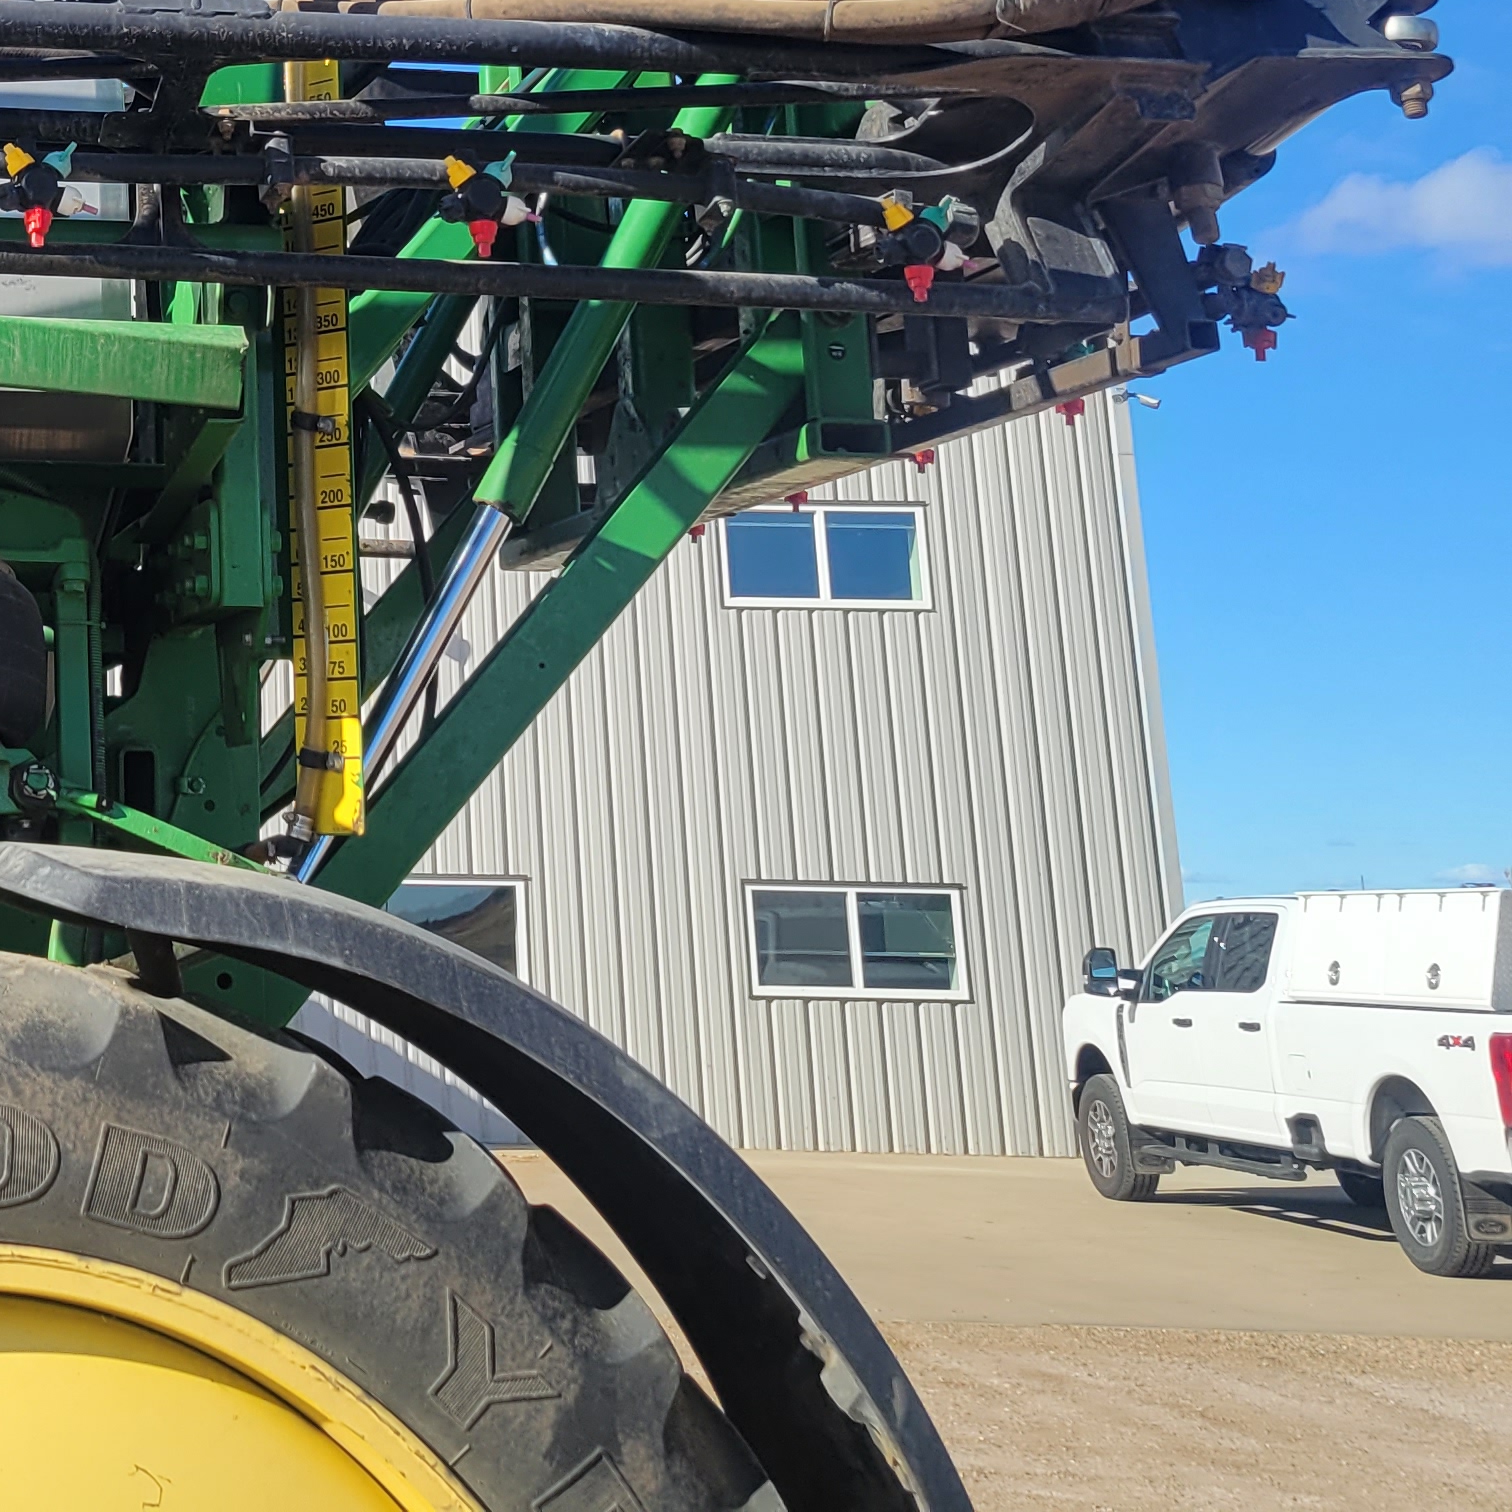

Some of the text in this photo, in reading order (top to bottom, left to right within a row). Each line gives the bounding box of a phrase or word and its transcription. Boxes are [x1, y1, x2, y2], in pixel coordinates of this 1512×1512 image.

[312, 202, 335, 219] 450
[316, 312, 338, 330] 350
[316, 369, 340, 386] 300
[319, 428, 342, 443] 250
[320, 489, 344, 504] 200
[322, 553, 346, 569] 150
[325, 622, 348, 638] 100
[299, 657, 307, 671] 3
[329, 661, 345, 676] 75
[301, 696, 308, 710] 2
[330, 699, 347, 714] 50
[332, 740, 348, 754] 25
